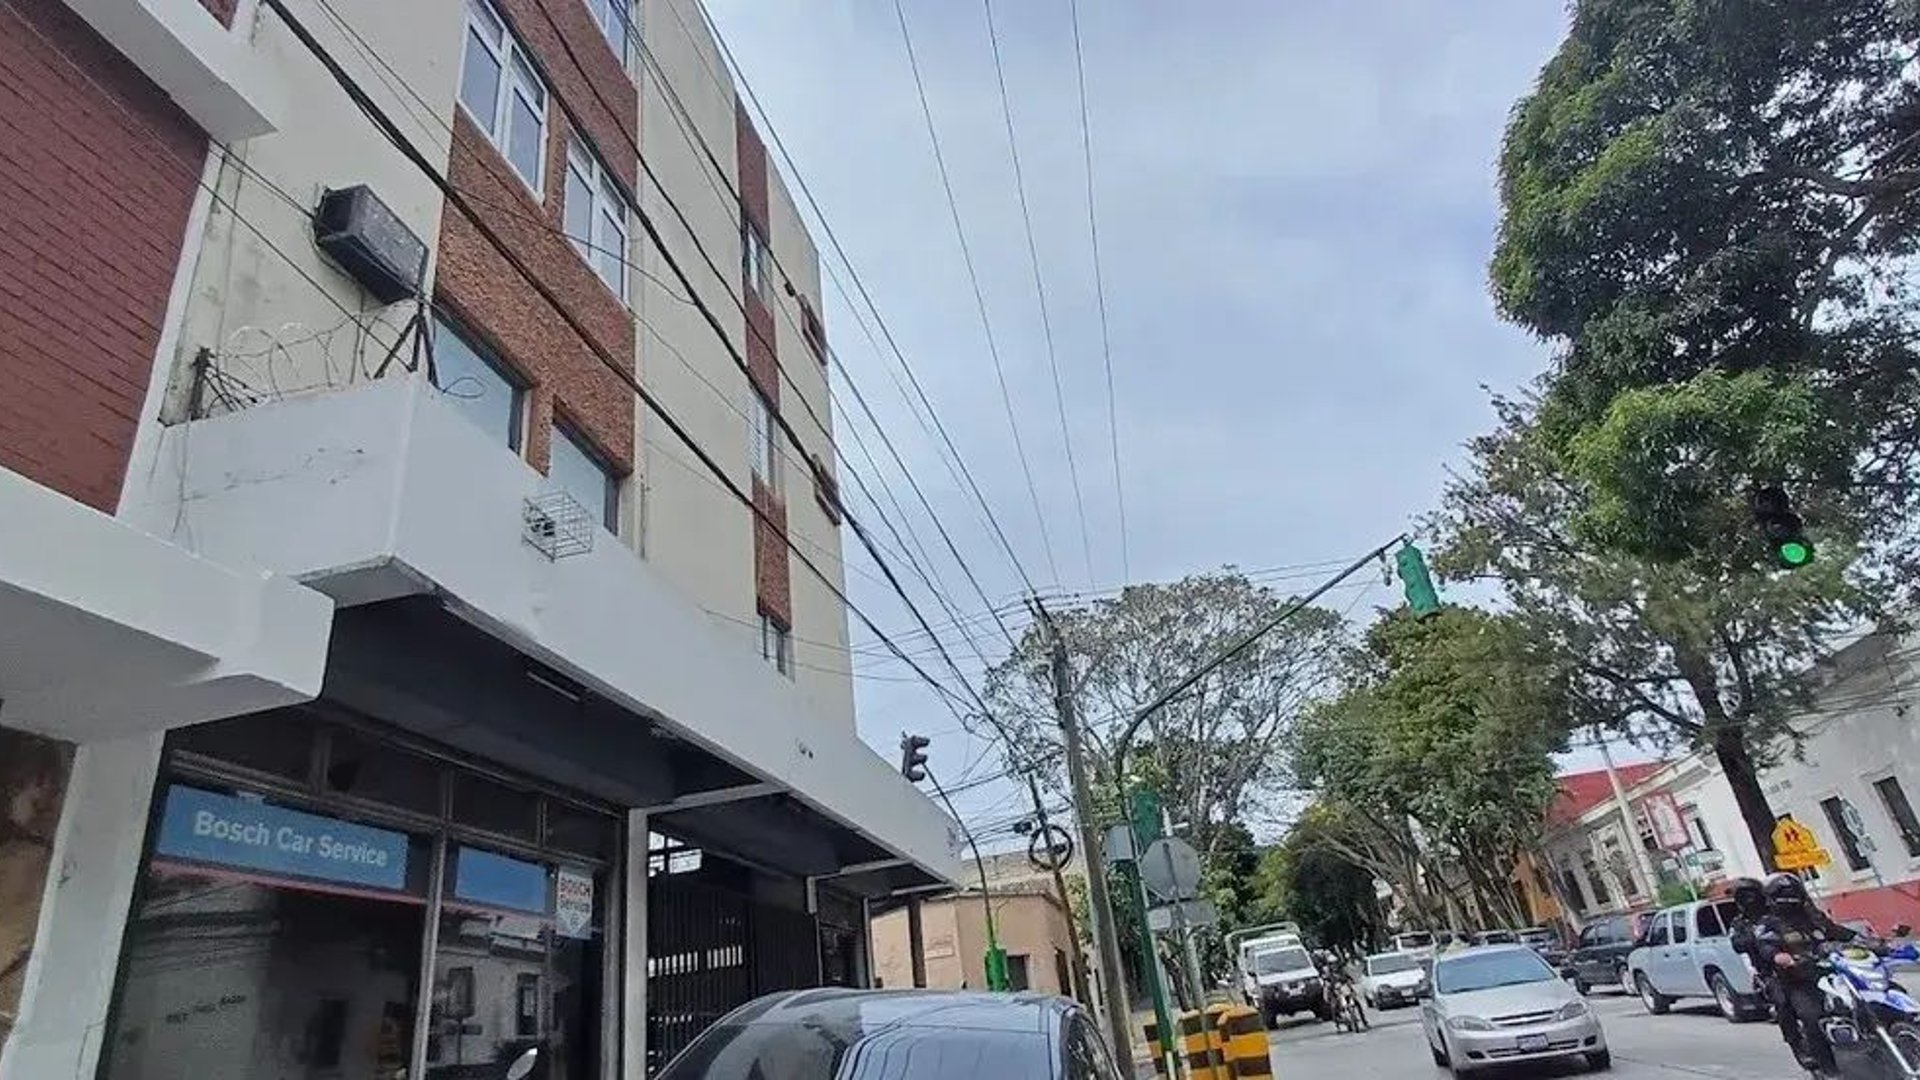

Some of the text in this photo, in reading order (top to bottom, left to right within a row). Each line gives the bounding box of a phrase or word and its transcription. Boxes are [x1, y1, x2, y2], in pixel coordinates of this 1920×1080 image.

[194, 809, 389, 867] Bosch Car Service
